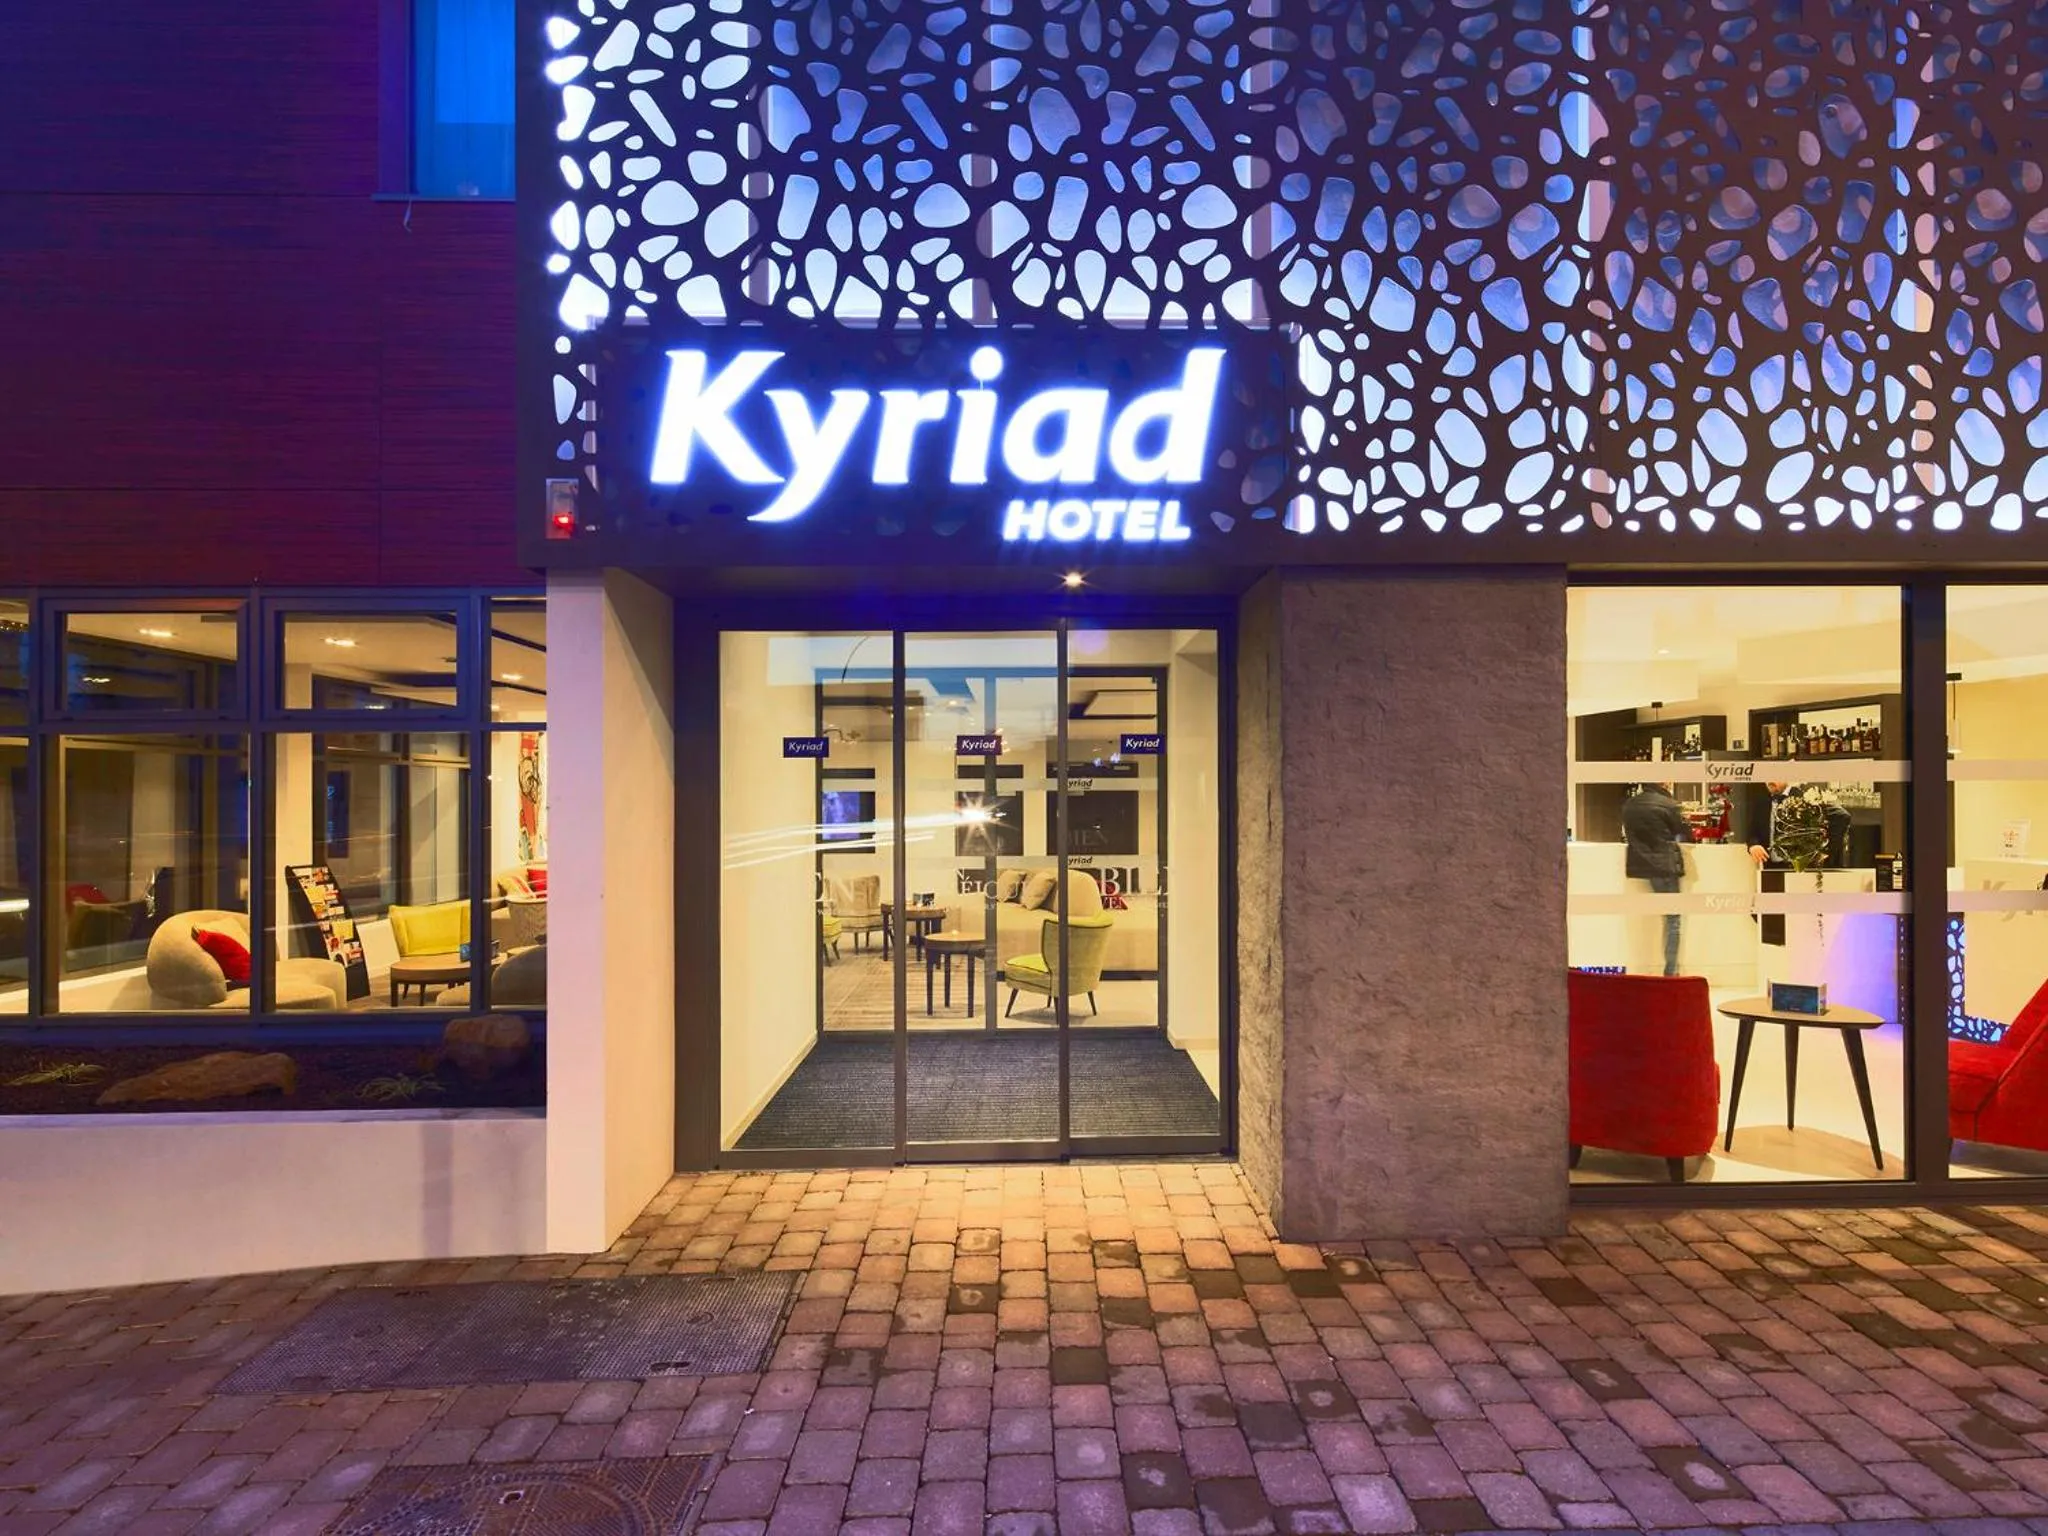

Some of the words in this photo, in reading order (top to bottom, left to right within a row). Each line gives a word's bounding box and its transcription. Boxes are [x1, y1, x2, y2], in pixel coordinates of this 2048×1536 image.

[650, 346, 1227, 522] Kyriad
[1002, 499, 1192, 541] HOTEL
[788, 741, 824, 753] Kyriad
[962, 739, 996, 750] Kyriad
[1125, 738, 1160, 749] Kyriad
[1068, 779, 1093, 789] yriad
[1068, 856, 1093, 866] yriad
